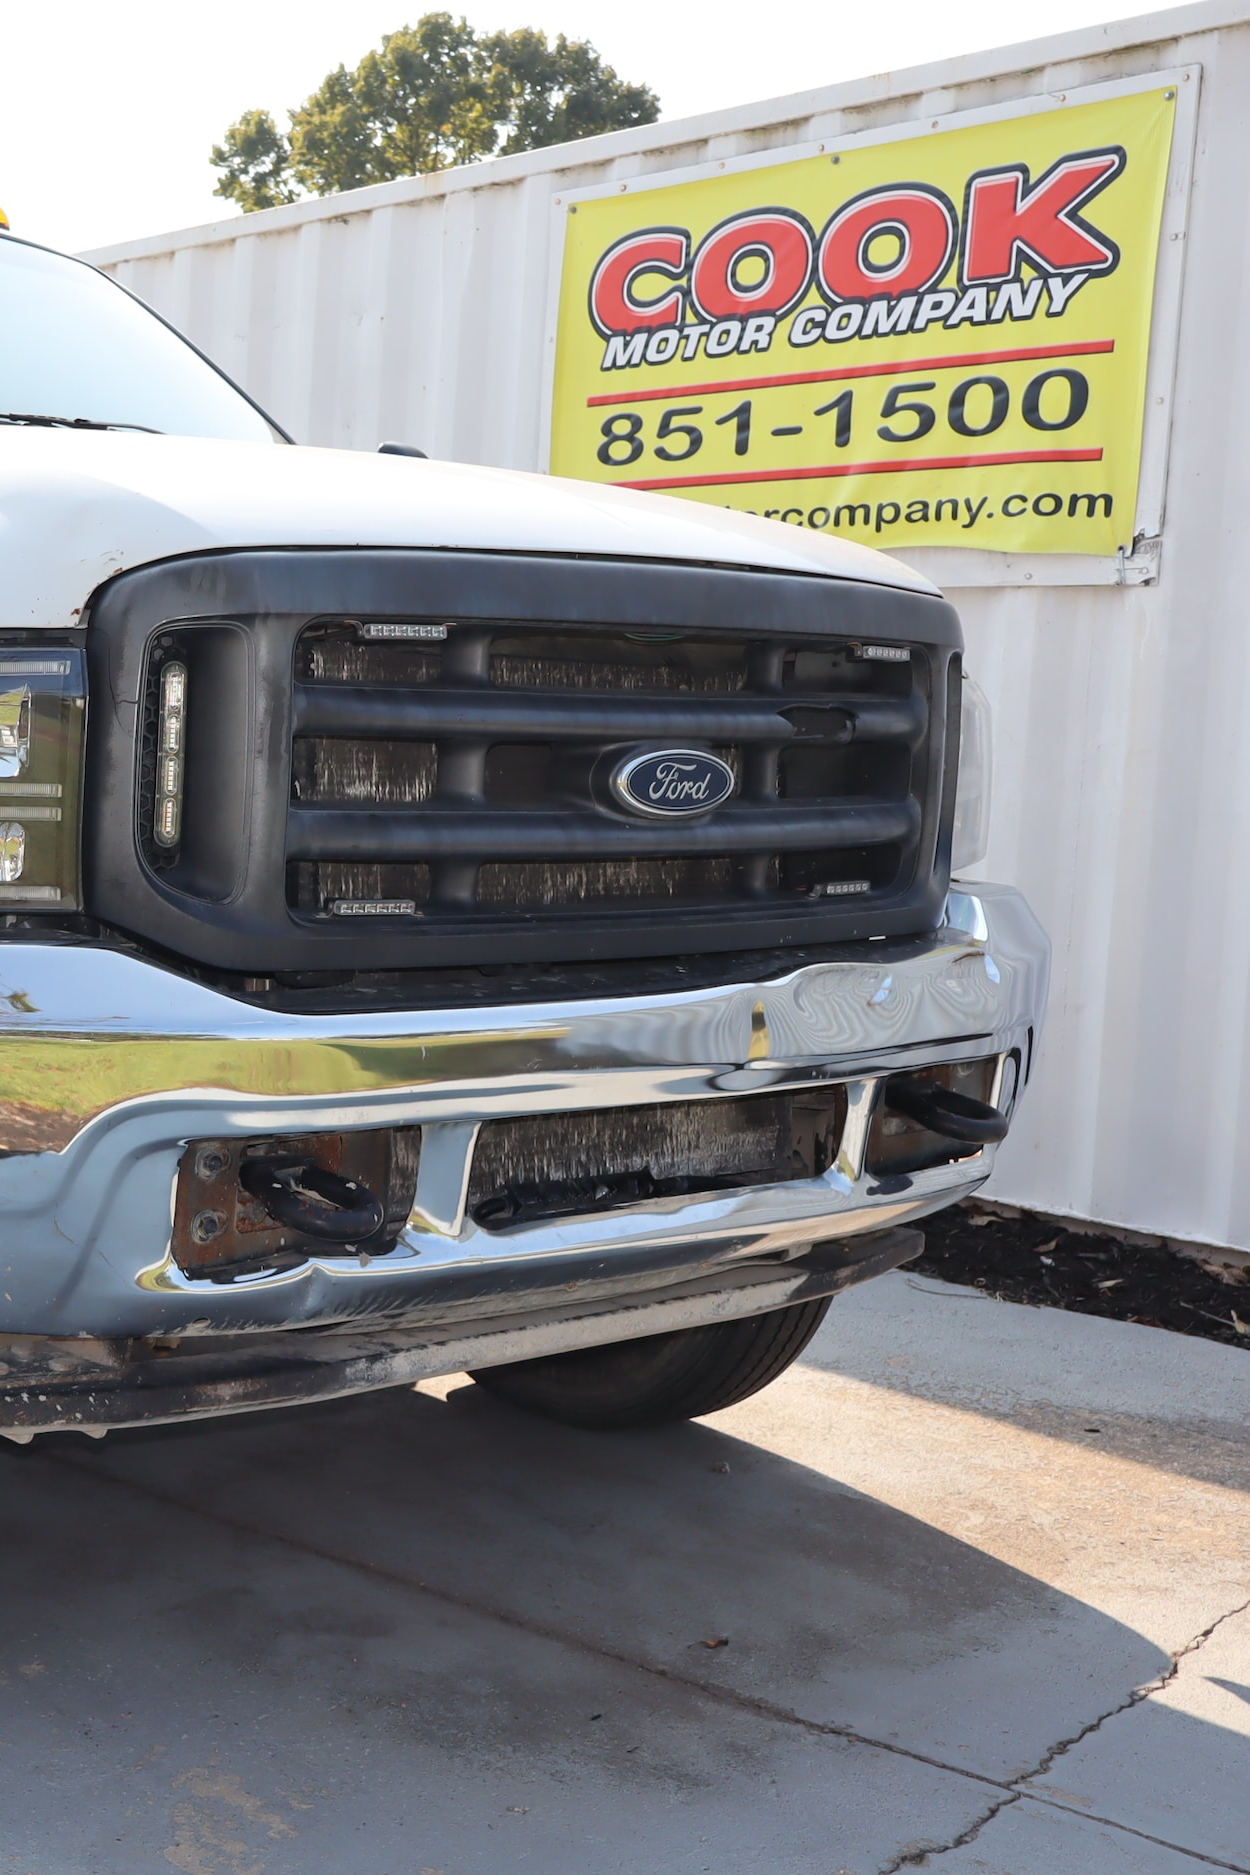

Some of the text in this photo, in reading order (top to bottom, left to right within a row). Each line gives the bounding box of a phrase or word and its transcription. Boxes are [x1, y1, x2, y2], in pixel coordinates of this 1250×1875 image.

[589, 145, 1127, 341] COOK
[601, 271, 1090, 371] MOTOR COMPANY
[597, 368, 1089, 466] 851-1500
[724, 493, 1113, 533] rcompany.com
[649, 762, 711, 800] Ford
